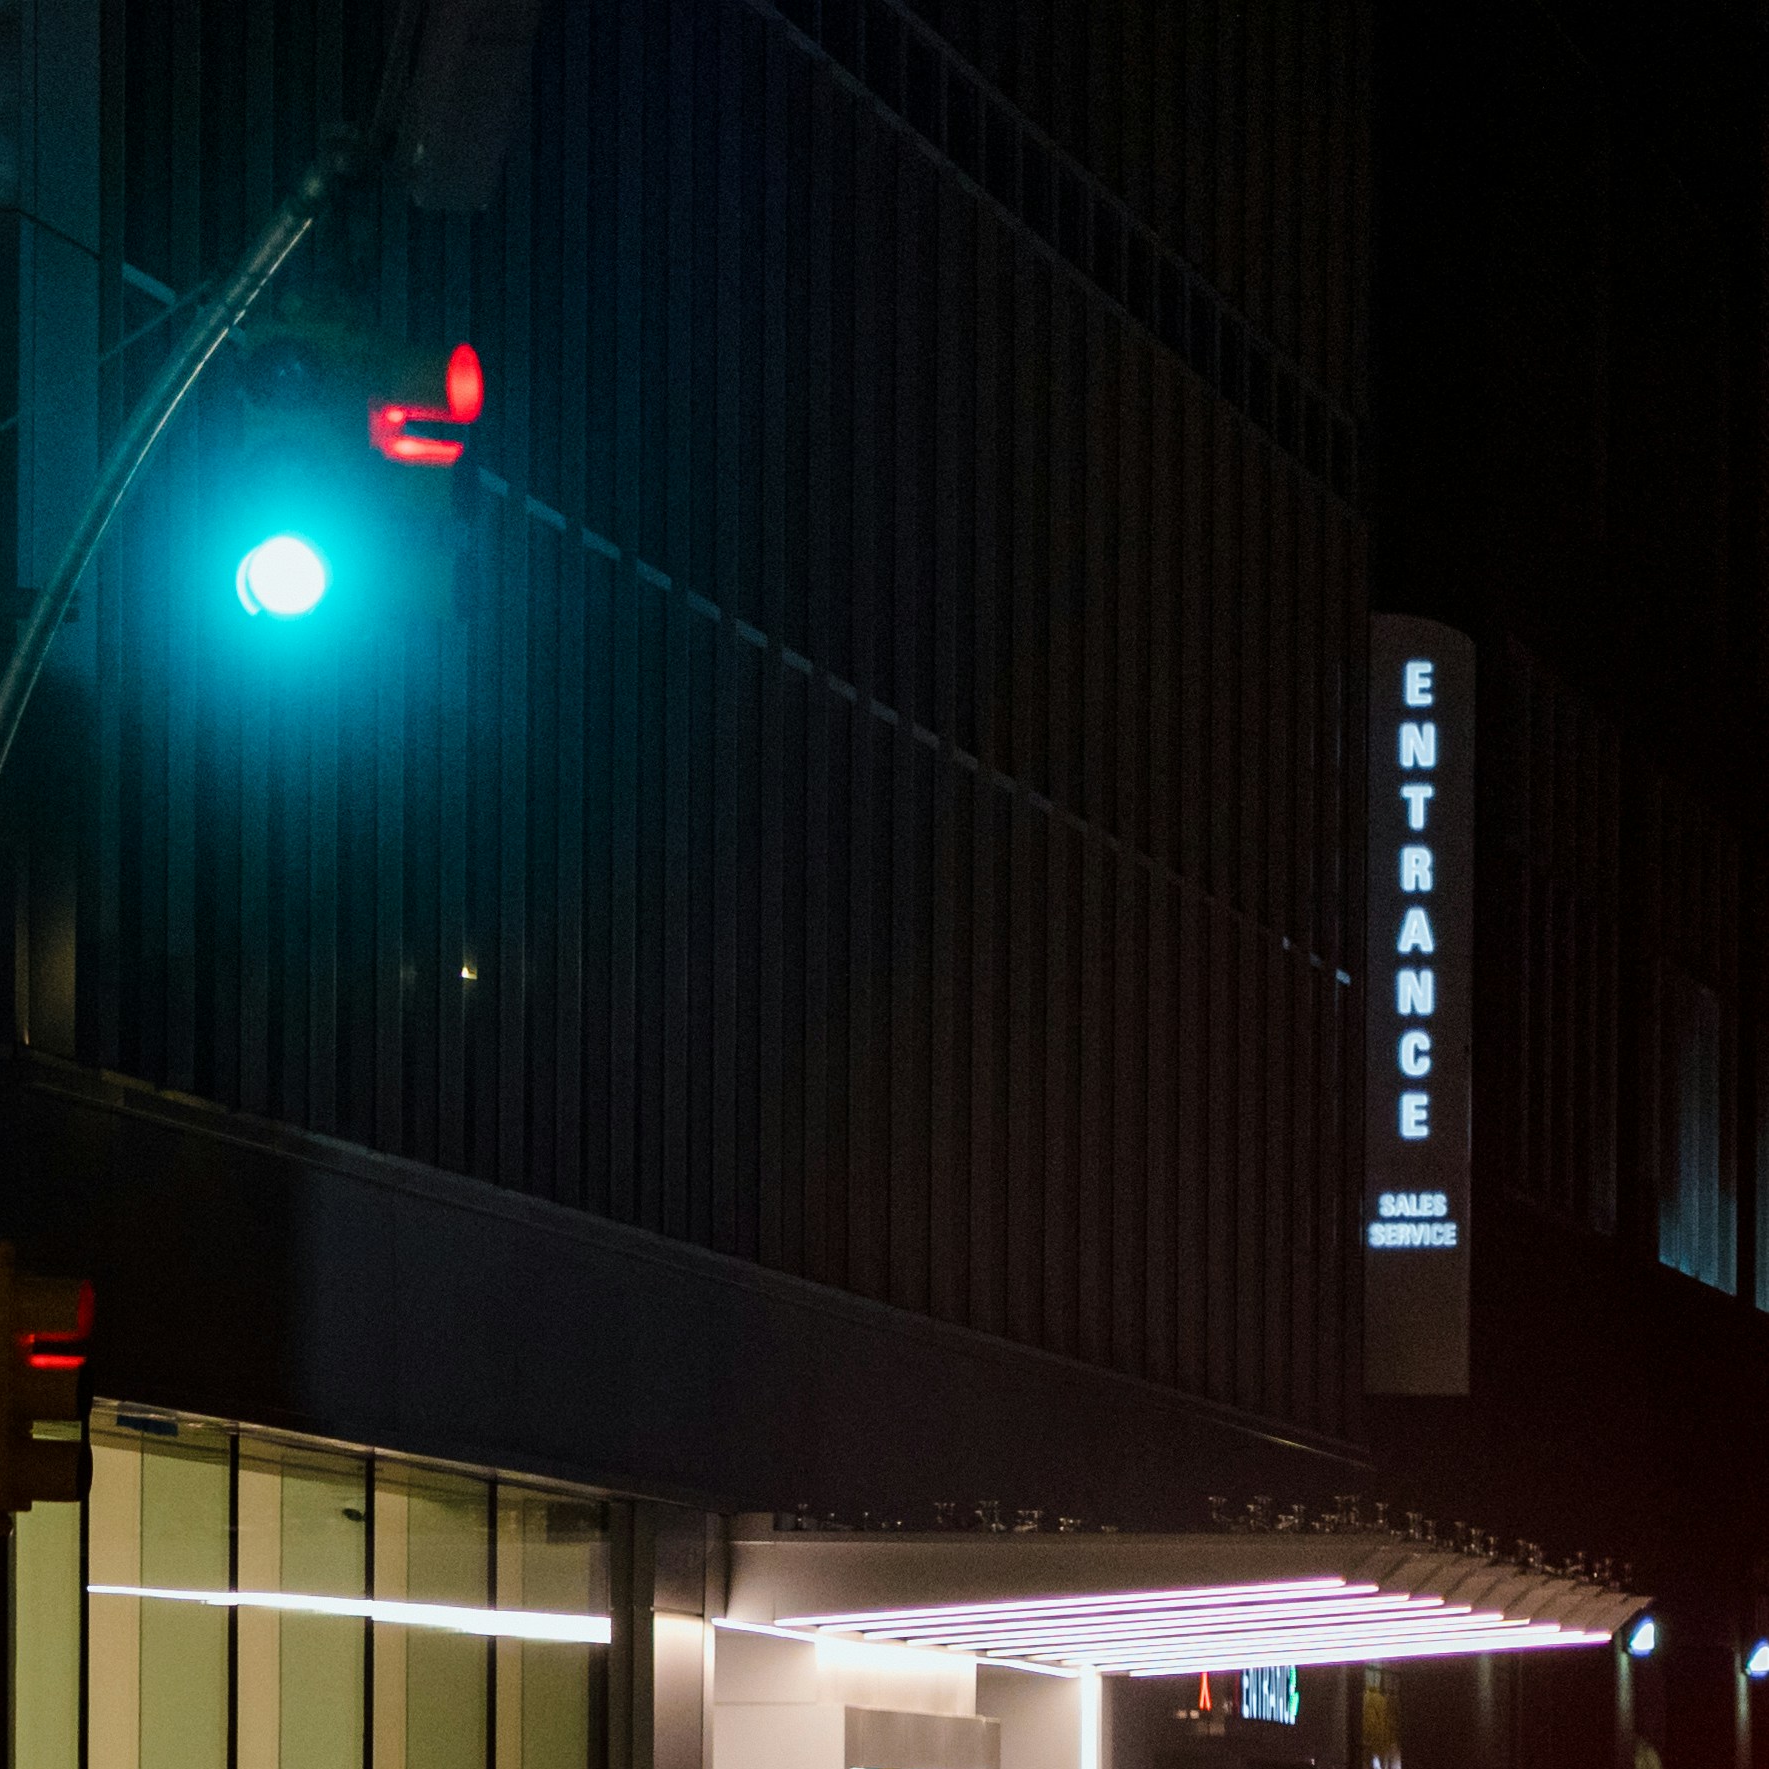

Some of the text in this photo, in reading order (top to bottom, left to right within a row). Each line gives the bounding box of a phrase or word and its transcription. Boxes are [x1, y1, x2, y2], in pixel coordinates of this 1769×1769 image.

[1396, 659, 1438, 1141] ENTRANCE
[1378, 1191, 1448, 1217] SALES
[1367, 1221, 1457, 1248] SERVICE
